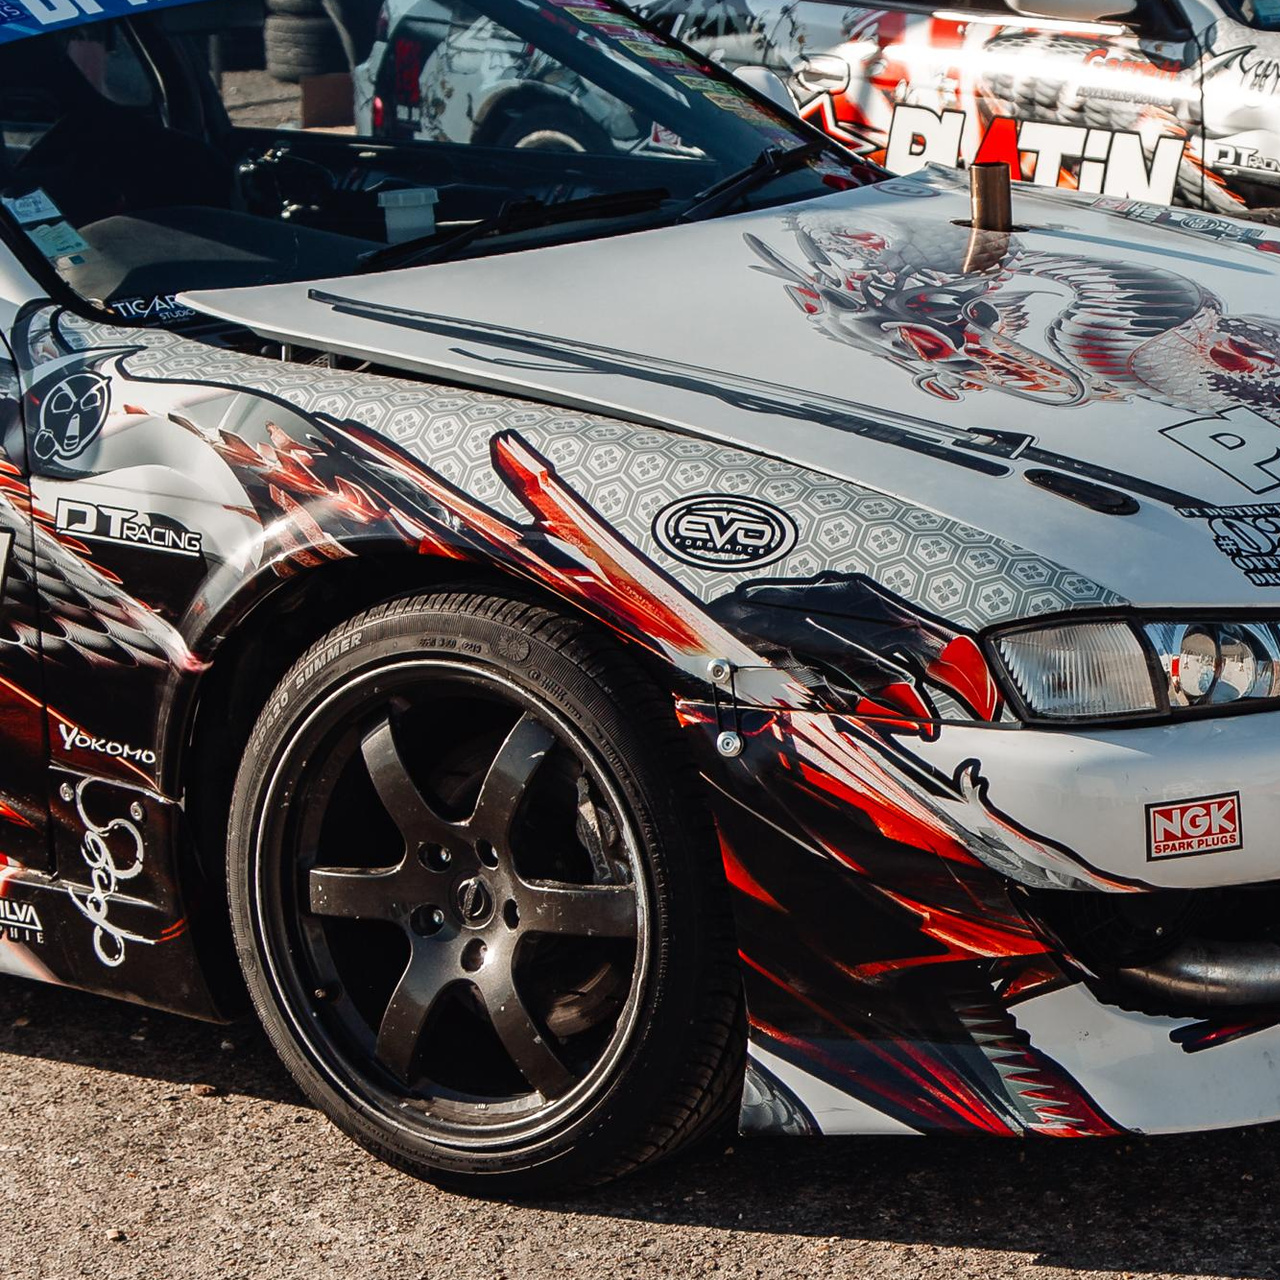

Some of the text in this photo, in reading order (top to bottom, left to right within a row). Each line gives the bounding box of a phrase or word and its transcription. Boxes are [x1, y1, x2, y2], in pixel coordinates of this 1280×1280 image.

[56, 497, 202, 552] DT RACING
[678, 510, 773, 549] EVO
[295, 631, 364, 691] SUMMER
[1154, 800, 1236, 842] NGK
[1154, 834, 1237, 855] SPARK PLUGS
